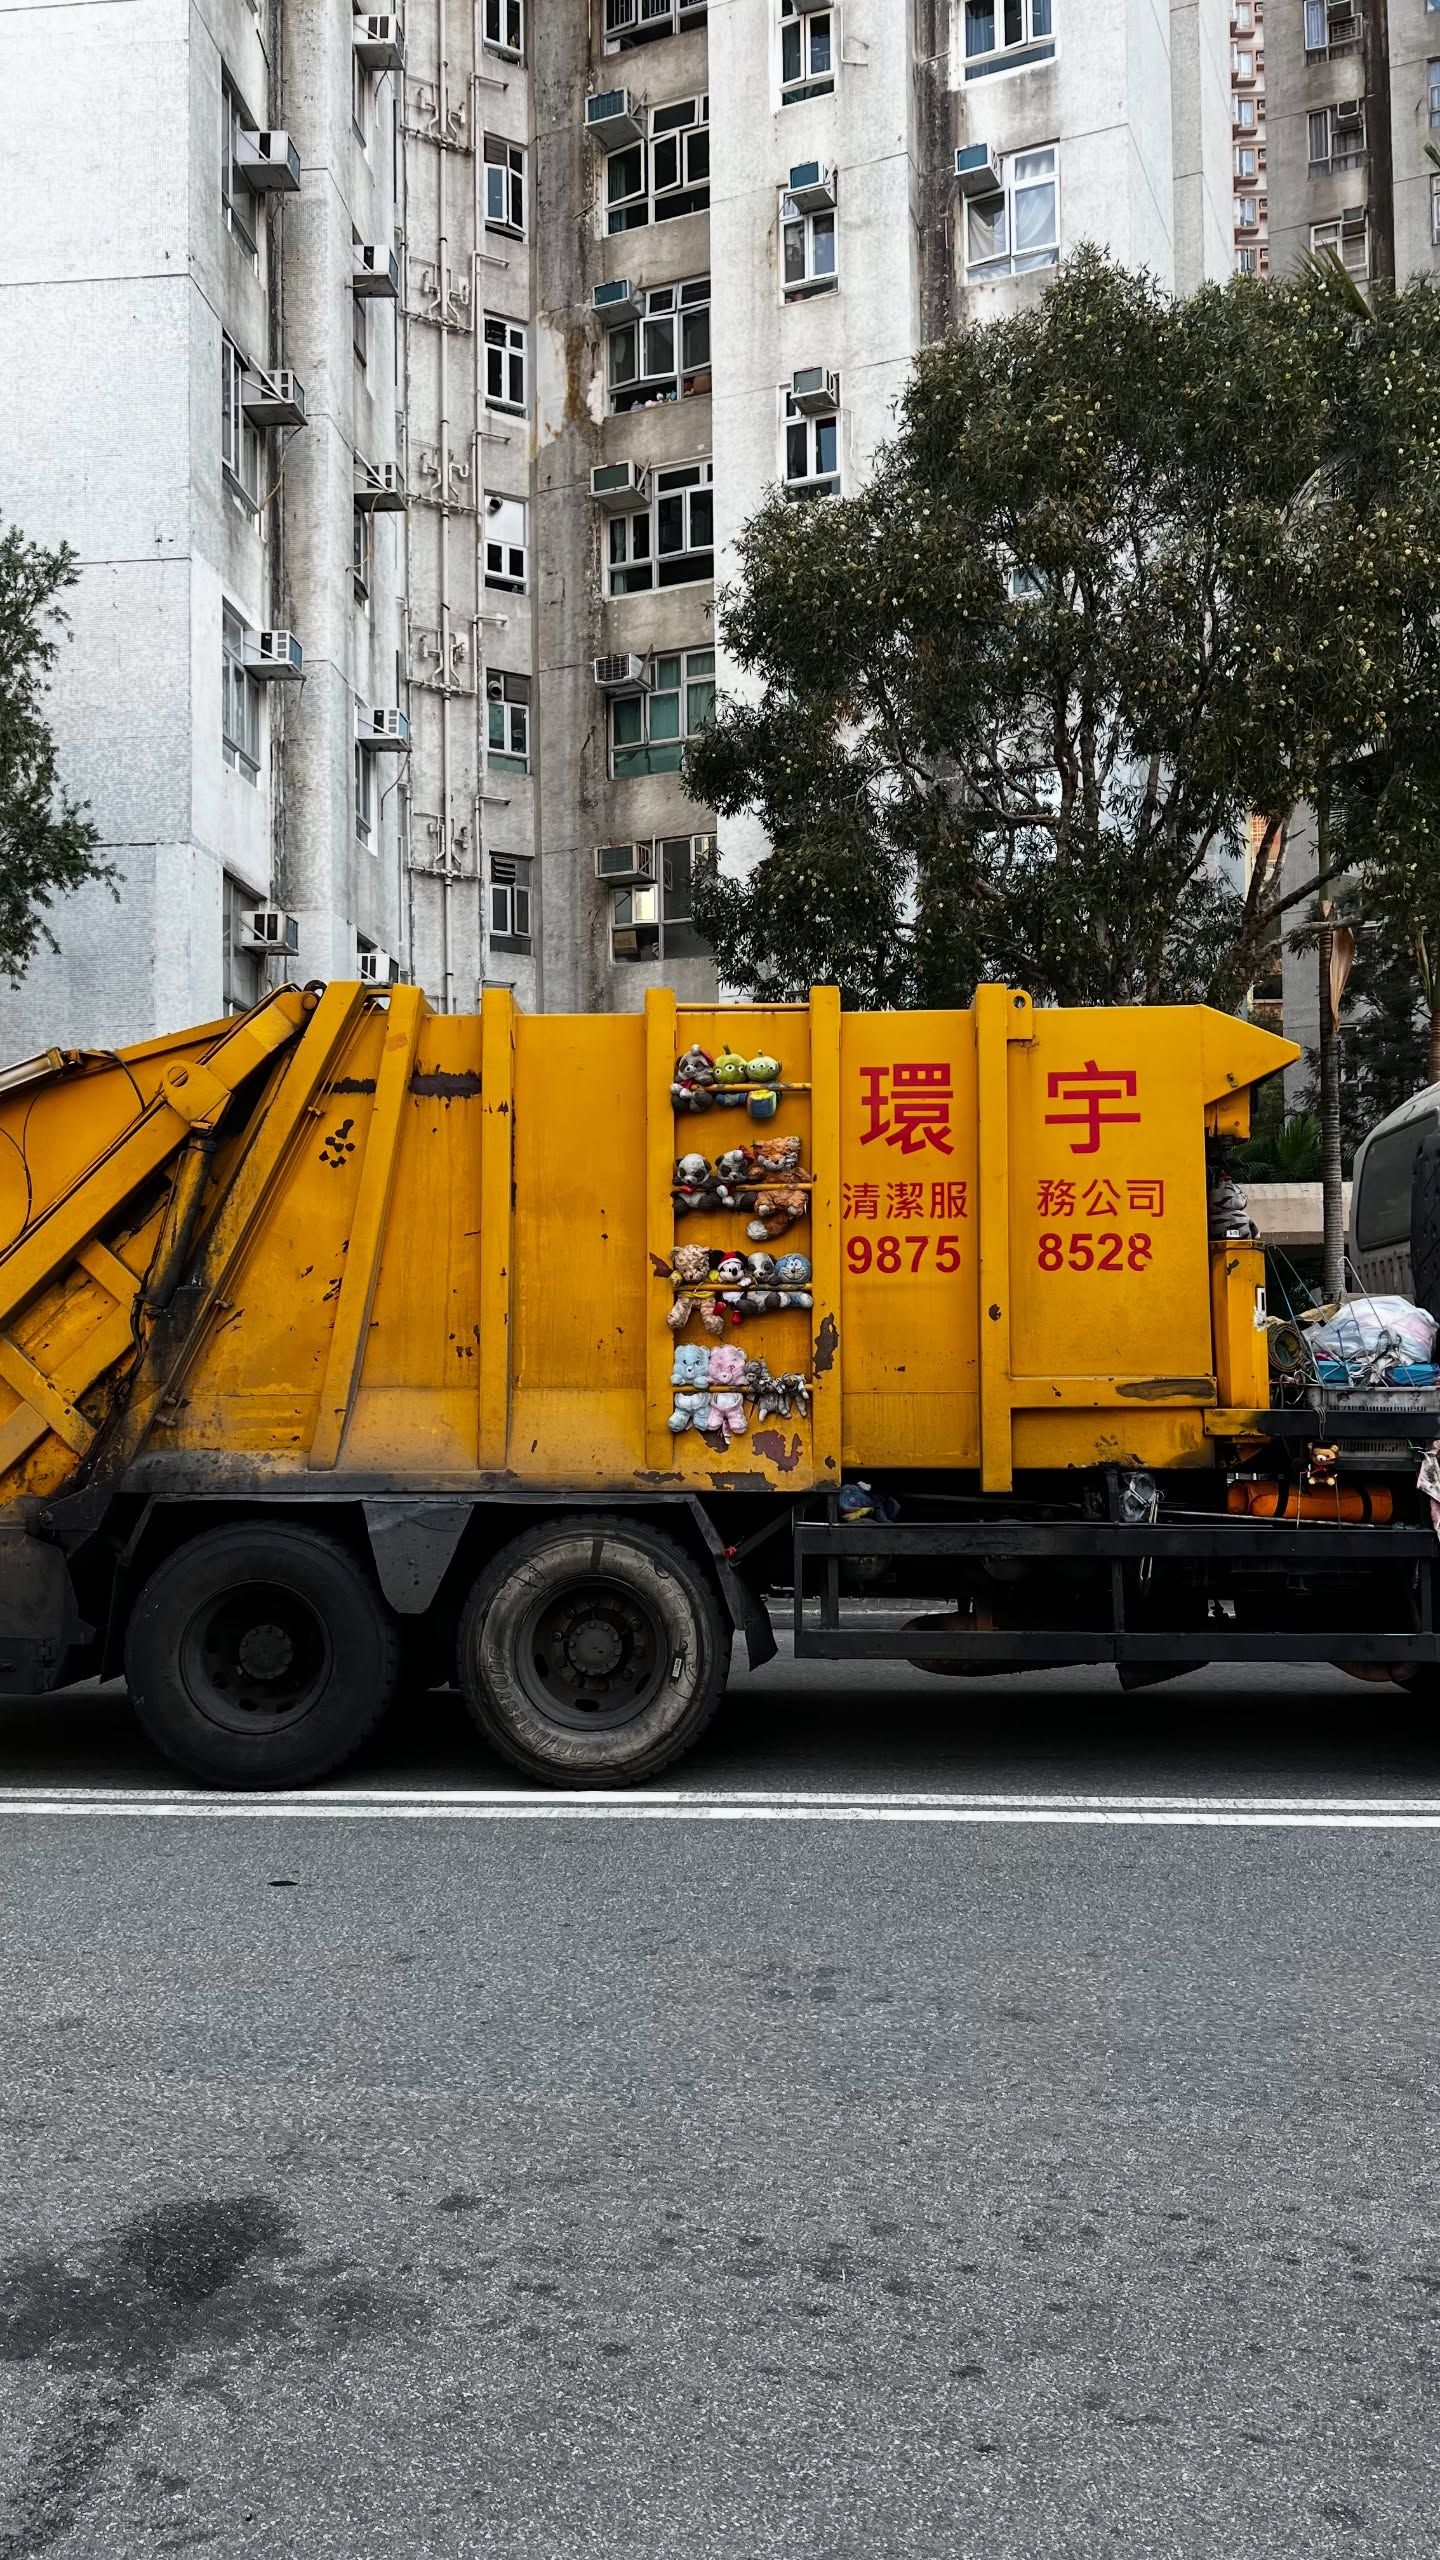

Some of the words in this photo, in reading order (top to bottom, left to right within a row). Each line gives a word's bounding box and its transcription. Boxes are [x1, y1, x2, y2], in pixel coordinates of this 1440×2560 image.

[860, 1063, 954, 1155] 環
[1045, 1060, 1140, 1153] 宇
[843, 1182, 968, 1220] 清潔服
[1037, 1179, 1163, 1217] 務公司
[846, 1234, 961, 1274] 9875
[1038, 1233, 1152, 1271] 8528
